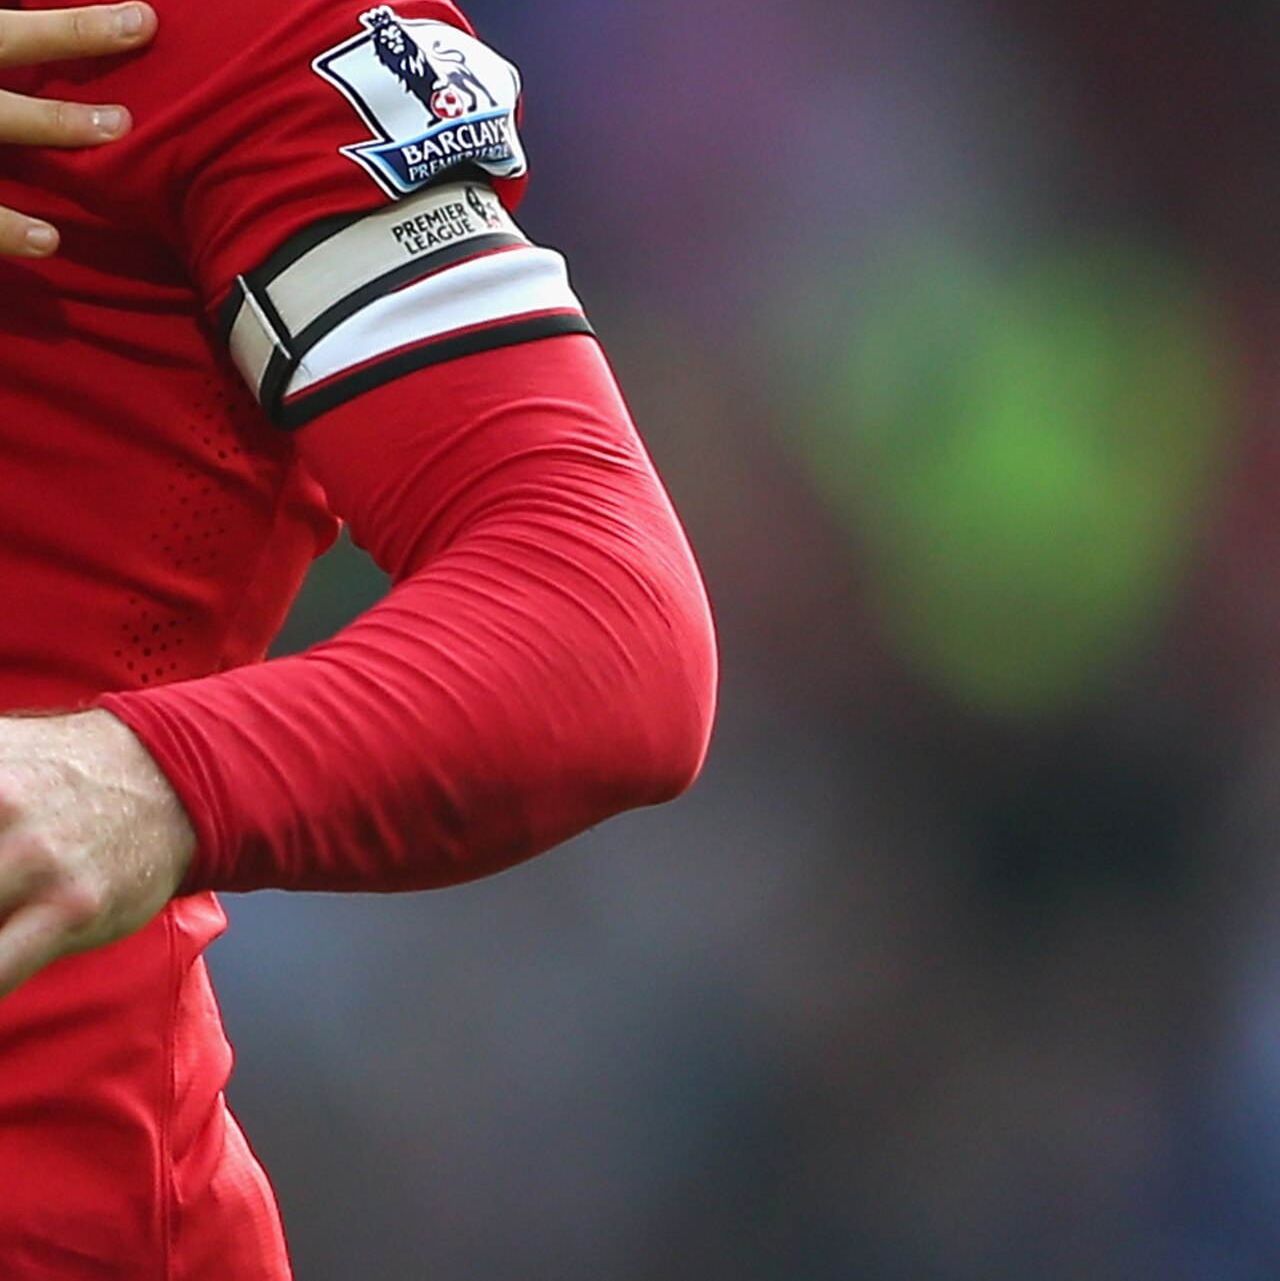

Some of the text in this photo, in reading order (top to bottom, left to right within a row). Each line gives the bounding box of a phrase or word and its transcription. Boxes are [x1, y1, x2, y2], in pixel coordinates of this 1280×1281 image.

[400, 116, 509, 166] BARCLAYS
[391, 202, 468, 243] PREMIER
[403, 219, 476, 255] LEAGUE
